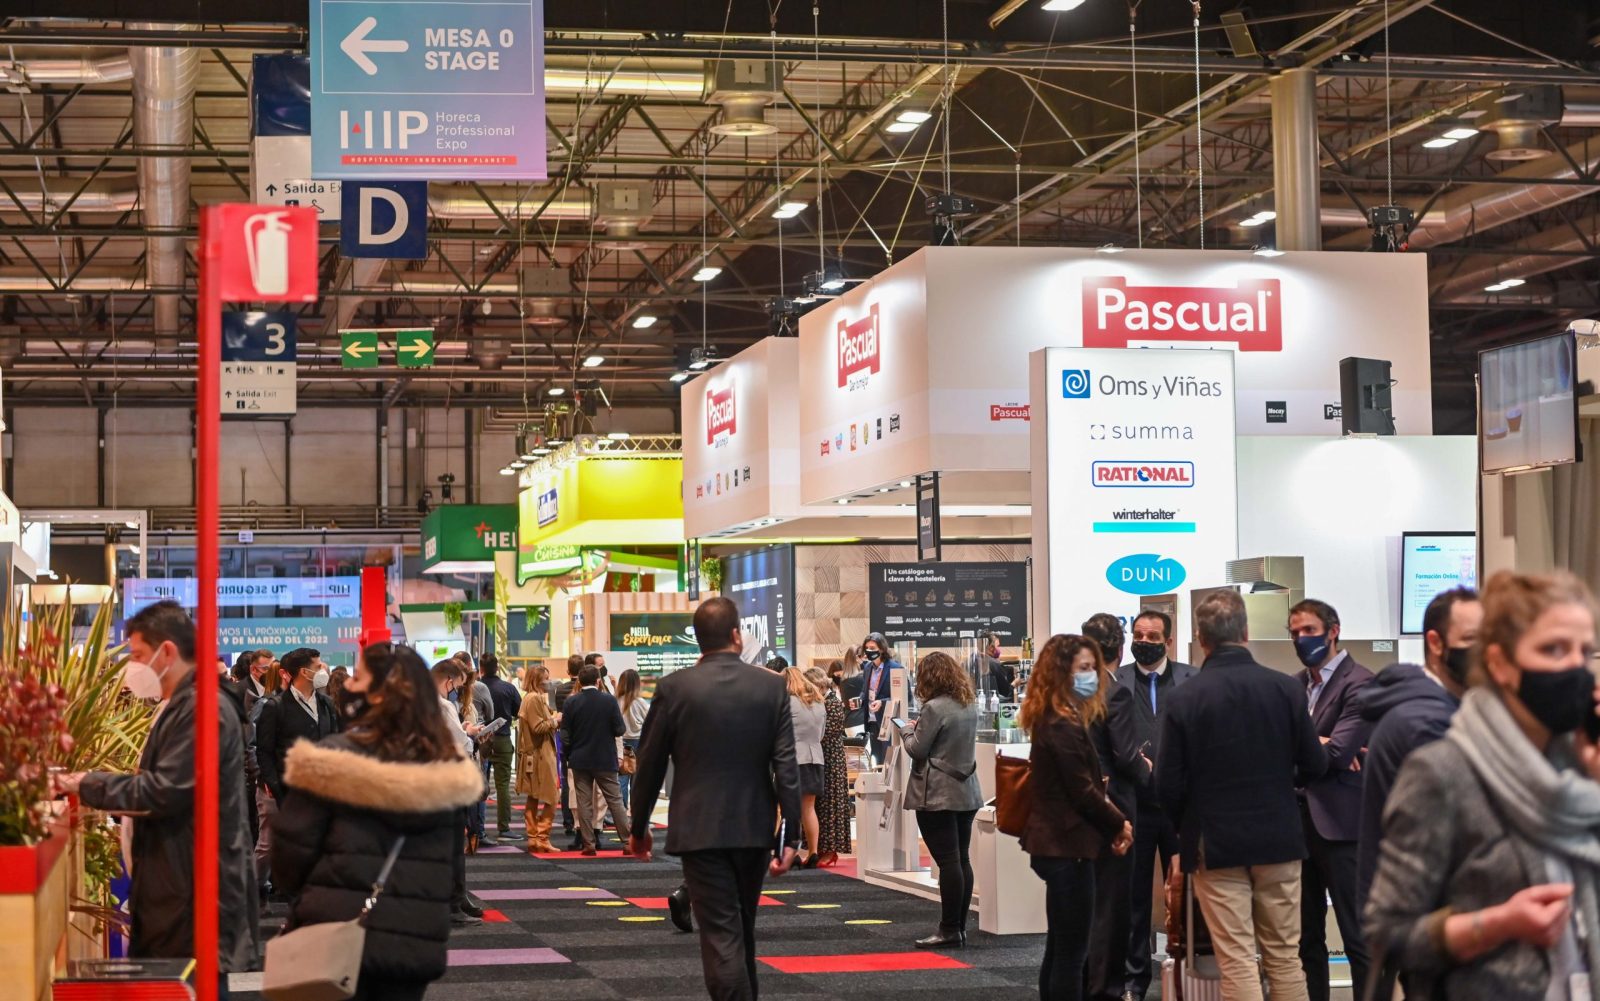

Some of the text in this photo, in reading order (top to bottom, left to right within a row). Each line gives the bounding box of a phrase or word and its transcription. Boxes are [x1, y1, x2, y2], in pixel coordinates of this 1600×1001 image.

[425, 28, 491, 47] MESA
[424, 51, 499, 71] STAGE
[436, 111, 481, 122] Horeca
[340, 110, 429, 149] HIP
[436, 124, 515, 136] Professional
[436, 138, 468, 151] Expo
[284, 182, 341, 194] Salida Ex
[359, 187, 409, 245] D
[1096, 287, 1267, 332] Pascual
[265, 323, 286, 355] 3
[839, 314, 878, 369] Pascual
[236, 390, 260, 398] Salida
[1099, 375, 1222, 400] Oms y Viñas
[708, 385, 735, 430] Pascual
[993, 407, 1030, 417] Pascual
[1326, 406, 1342, 416] Pas
[1112, 425, 1194, 440] summa
[1098, 466, 1190, 482] RATIONAL
[1113, 508, 1176, 520] winterhalter
[484, 531, 516, 548] HEI
[1121, 567, 1171, 582] DUNI
[219, 625, 322, 635] MOS EL PRÓXIMO AÑO
[232, 636, 244, 644] DE
[248, 636, 281, 644] MARZO
[285, 636, 302, 644] DEL
[305, 636, 328, 644] 2022
